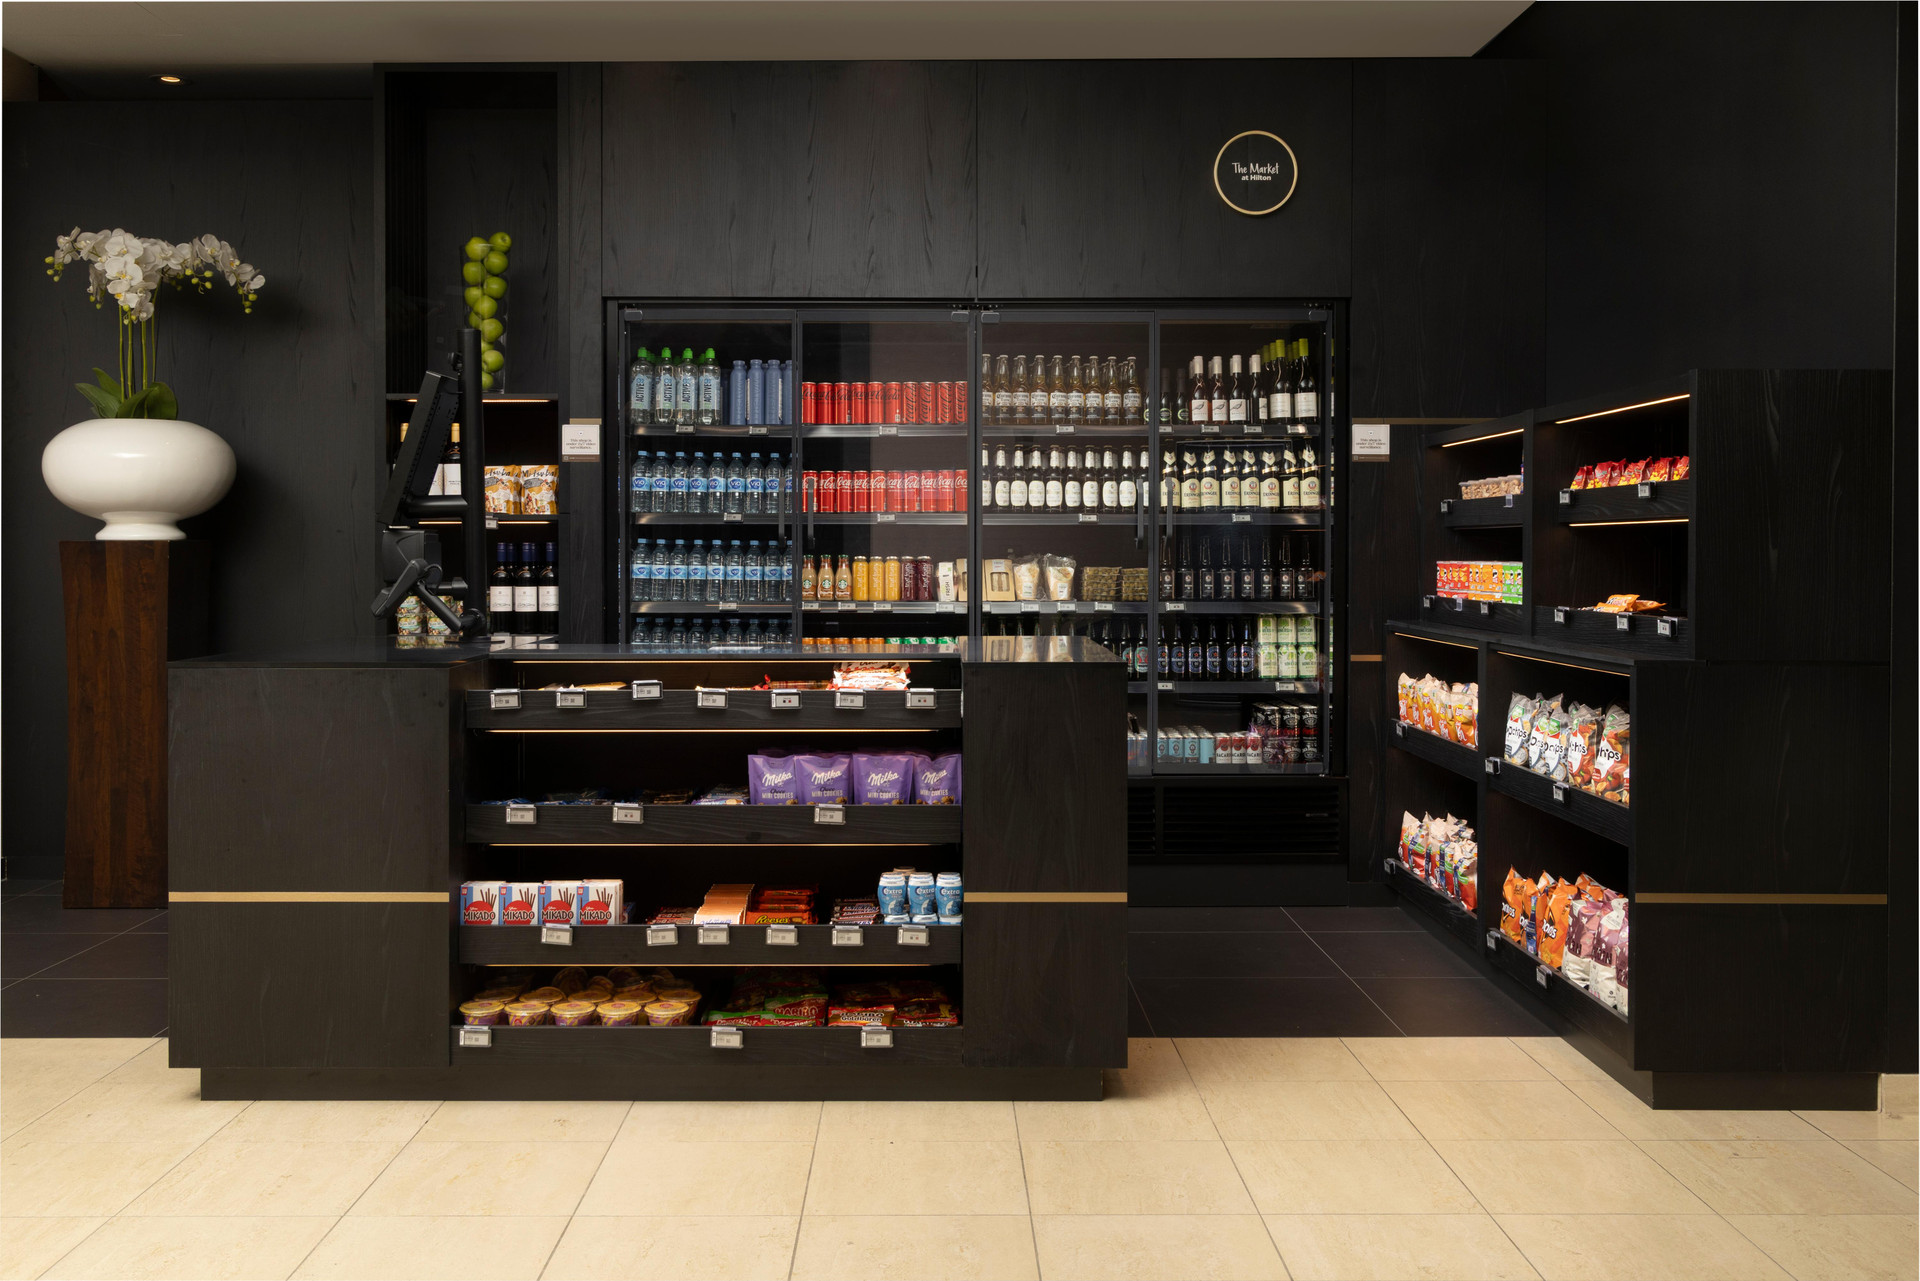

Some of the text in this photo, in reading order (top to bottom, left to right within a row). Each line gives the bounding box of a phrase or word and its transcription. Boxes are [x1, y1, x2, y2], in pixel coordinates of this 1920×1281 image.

[1232, 162, 1279, 174] The Market
[762, 771, 792, 786] Milka
[811, 770, 842, 785] Milka
[867, 771, 899, 786] Milka
[883, 887, 902, 895] extra
[916, 887, 934, 895] extra
[463, 911, 496, 920] MIKADO
[502, 911, 535, 920] MIKADO
[541, 910, 574, 920] MIKADO
[580, 910, 612, 920] MIKADO
[775, 1005, 819, 1017] HARIBO
